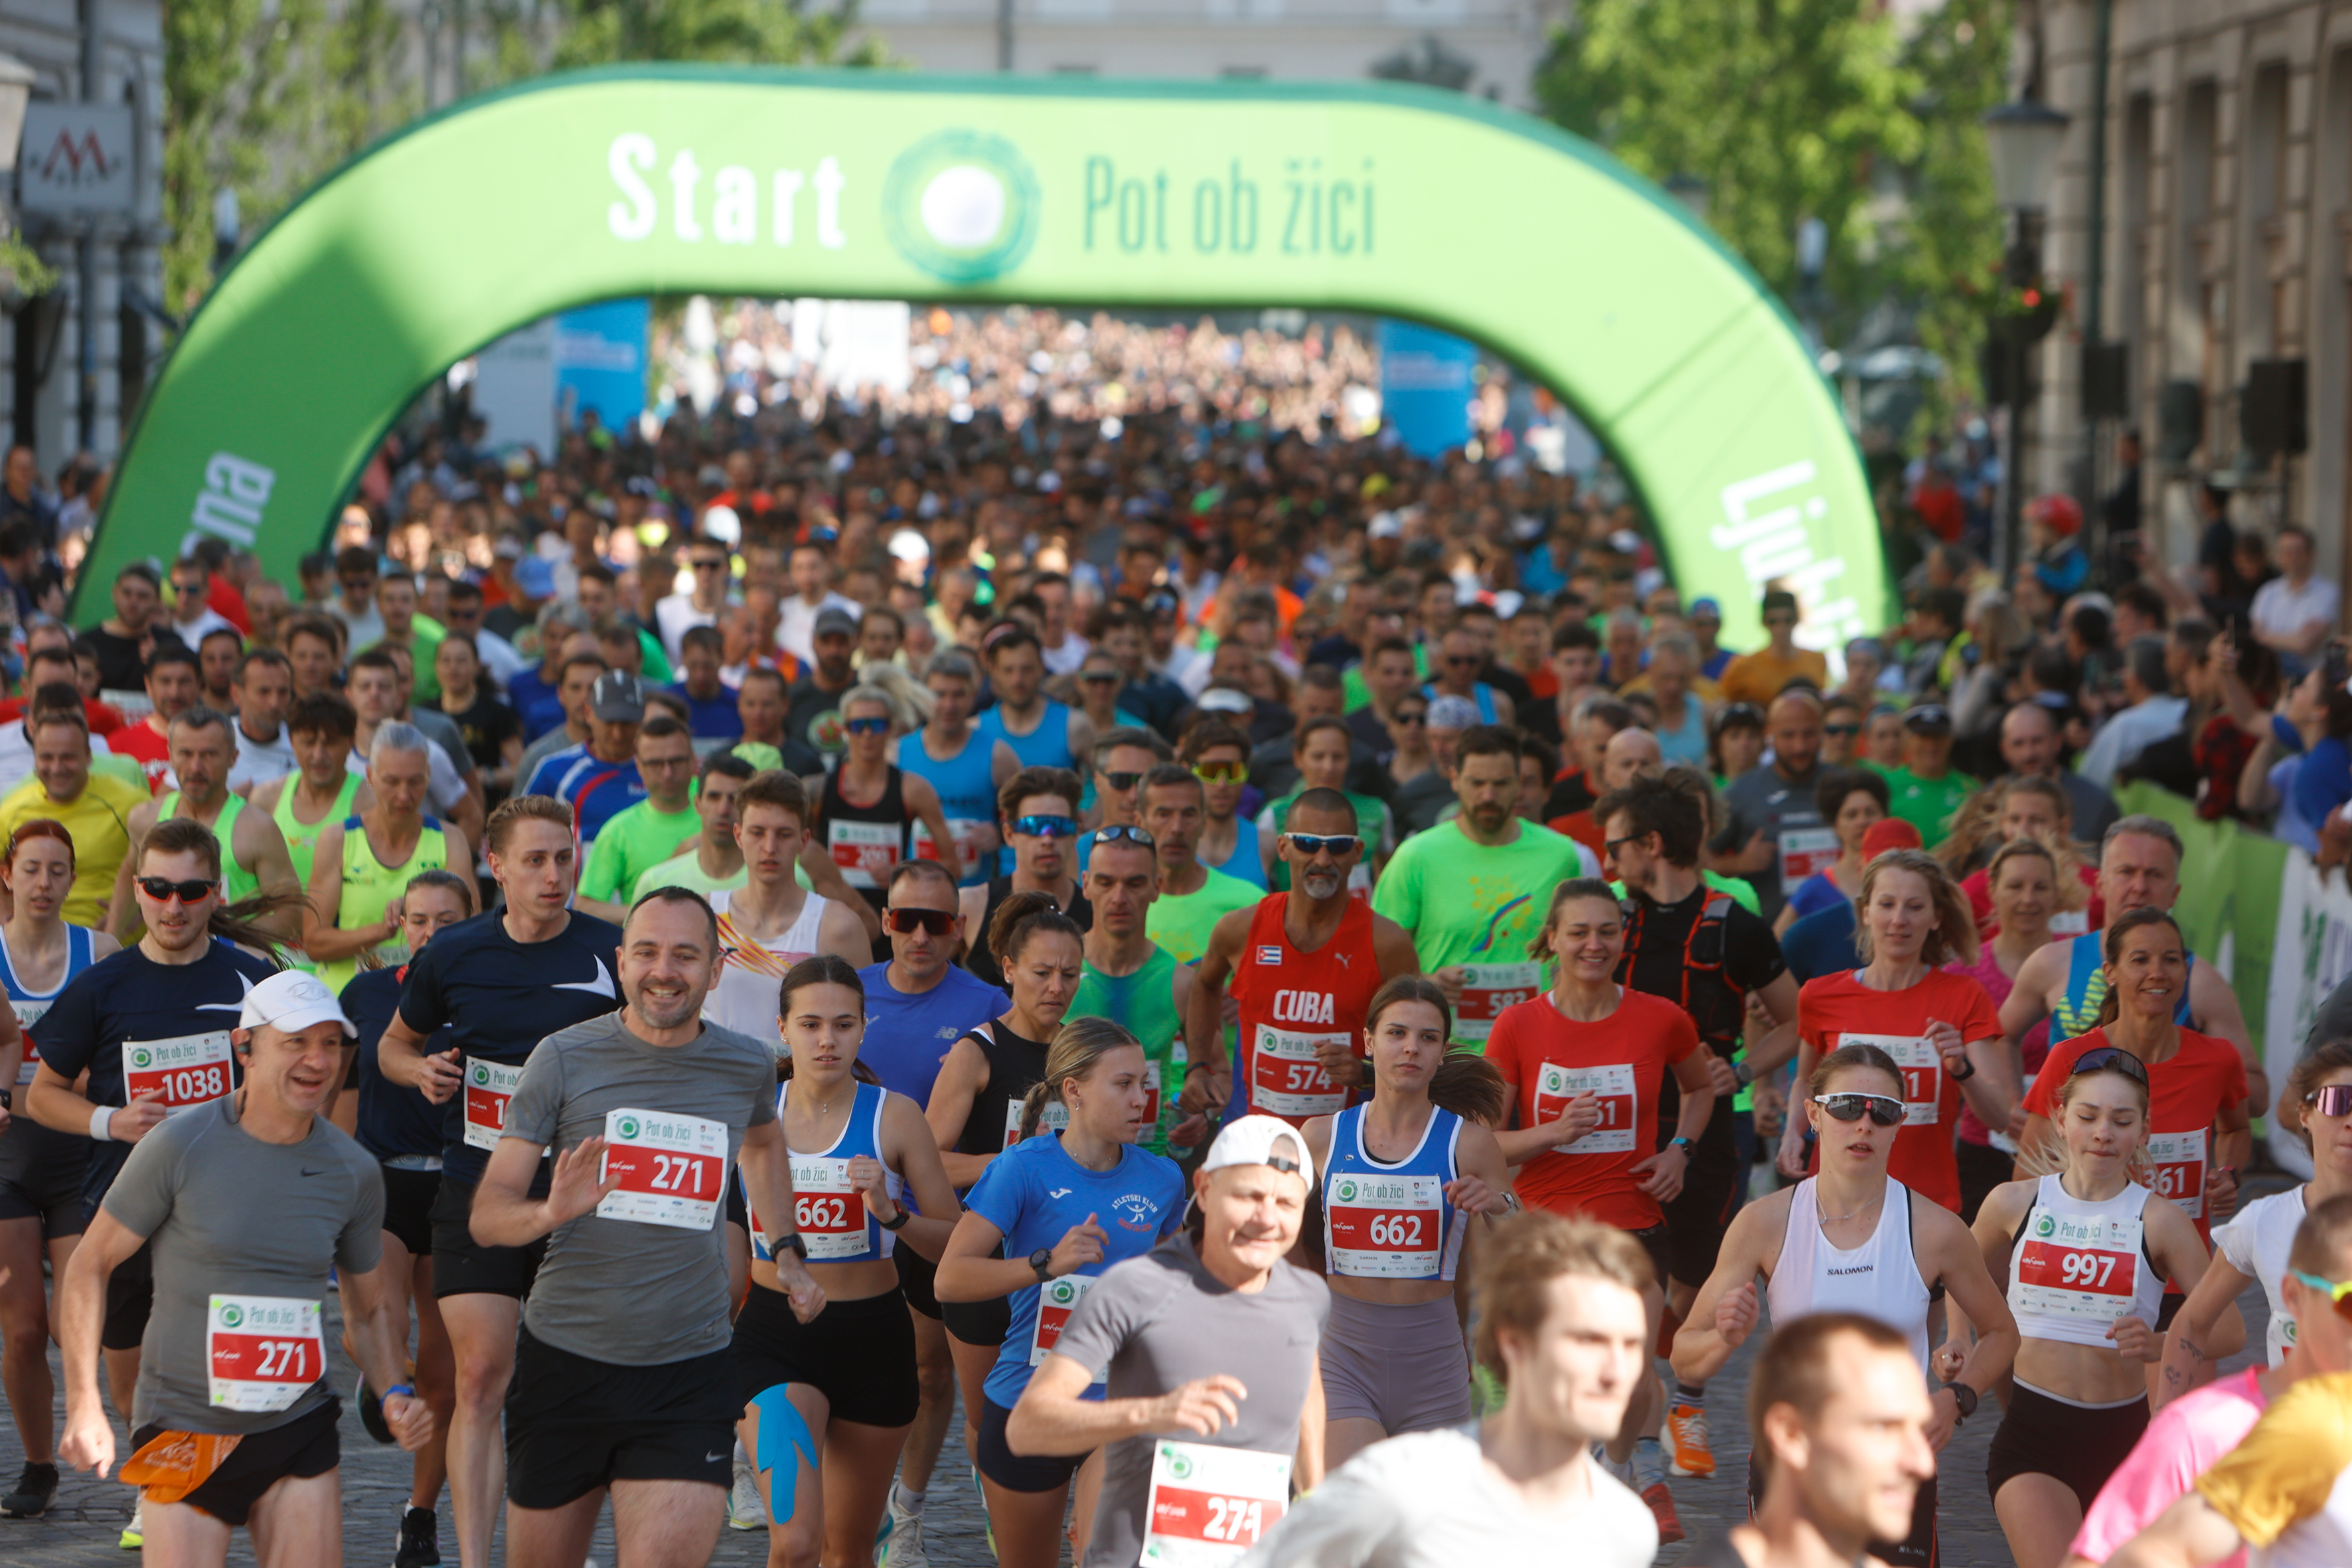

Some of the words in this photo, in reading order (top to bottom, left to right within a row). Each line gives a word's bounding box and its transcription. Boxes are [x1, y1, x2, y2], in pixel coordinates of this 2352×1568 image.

[607, 131, 848, 251] Start
[1083, 153, 1168, 254] Pot
[1193, 155, 1258, 255] ob
[1279, 155, 1376, 259] žici
[179, 450, 275, 559] na
[1273, 989, 1335, 1024] CUBA
[156, 1047, 169, 1061] Pot
[171, 1046, 181, 1059] ob
[183, 1043, 197, 1056] žici
[161, 1067, 223, 1101] 1038
[494, 1070, 506, 1084] Pot
[507, 1073, 517, 1086] ob
[1286, 1064, 1332, 1090] 574
[645, 1120, 661, 1137] Pot
[662, 1121, 673, 1138] ob
[674, 1124, 692, 1141] žici
[1052, 1109, 1061, 1122] ob
[651, 1154, 704, 1193] 271
[801, 1166, 811, 1182] ob
[813, 1166, 828, 1182] žici
[1111, 1194, 1141, 1210] ATLETSKI
[1142, 1196, 1158, 1213] KLUB
[1362, 1183, 1375, 1198] Pot
[1377, 1184, 1387, 1198] ob
[1389, 1184, 1404, 1199] žici
[795, 1197, 847, 1227] 662
[1370, 1214, 1422, 1246] 662
[2061, 1222, 2075, 1237] Pot
[2077, 1223, 2088, 1239] ob
[1828, 1265, 1873, 1276] SALOMON
[2062, 1253, 2116, 1287] 997
[255, 1340, 306, 1377] 271
[1203, 1496, 1262, 1543] 271
